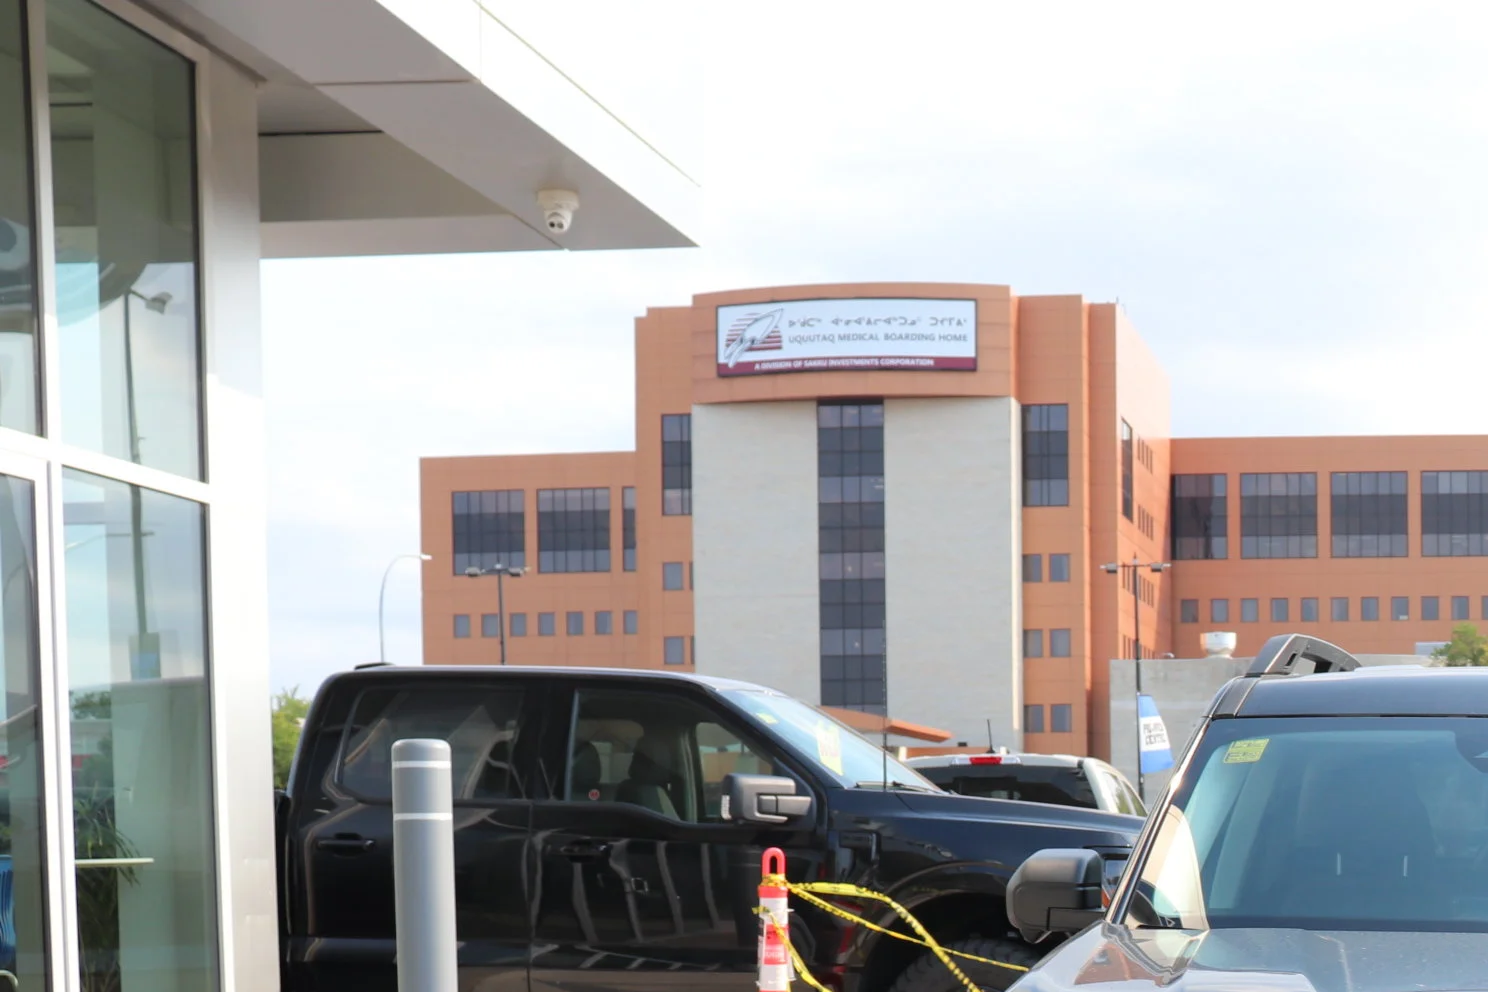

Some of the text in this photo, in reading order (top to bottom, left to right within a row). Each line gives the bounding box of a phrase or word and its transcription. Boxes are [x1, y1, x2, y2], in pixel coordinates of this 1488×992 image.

[788, 332, 968, 345] UQUUTAQ MEDICAL BOARDING HOME
